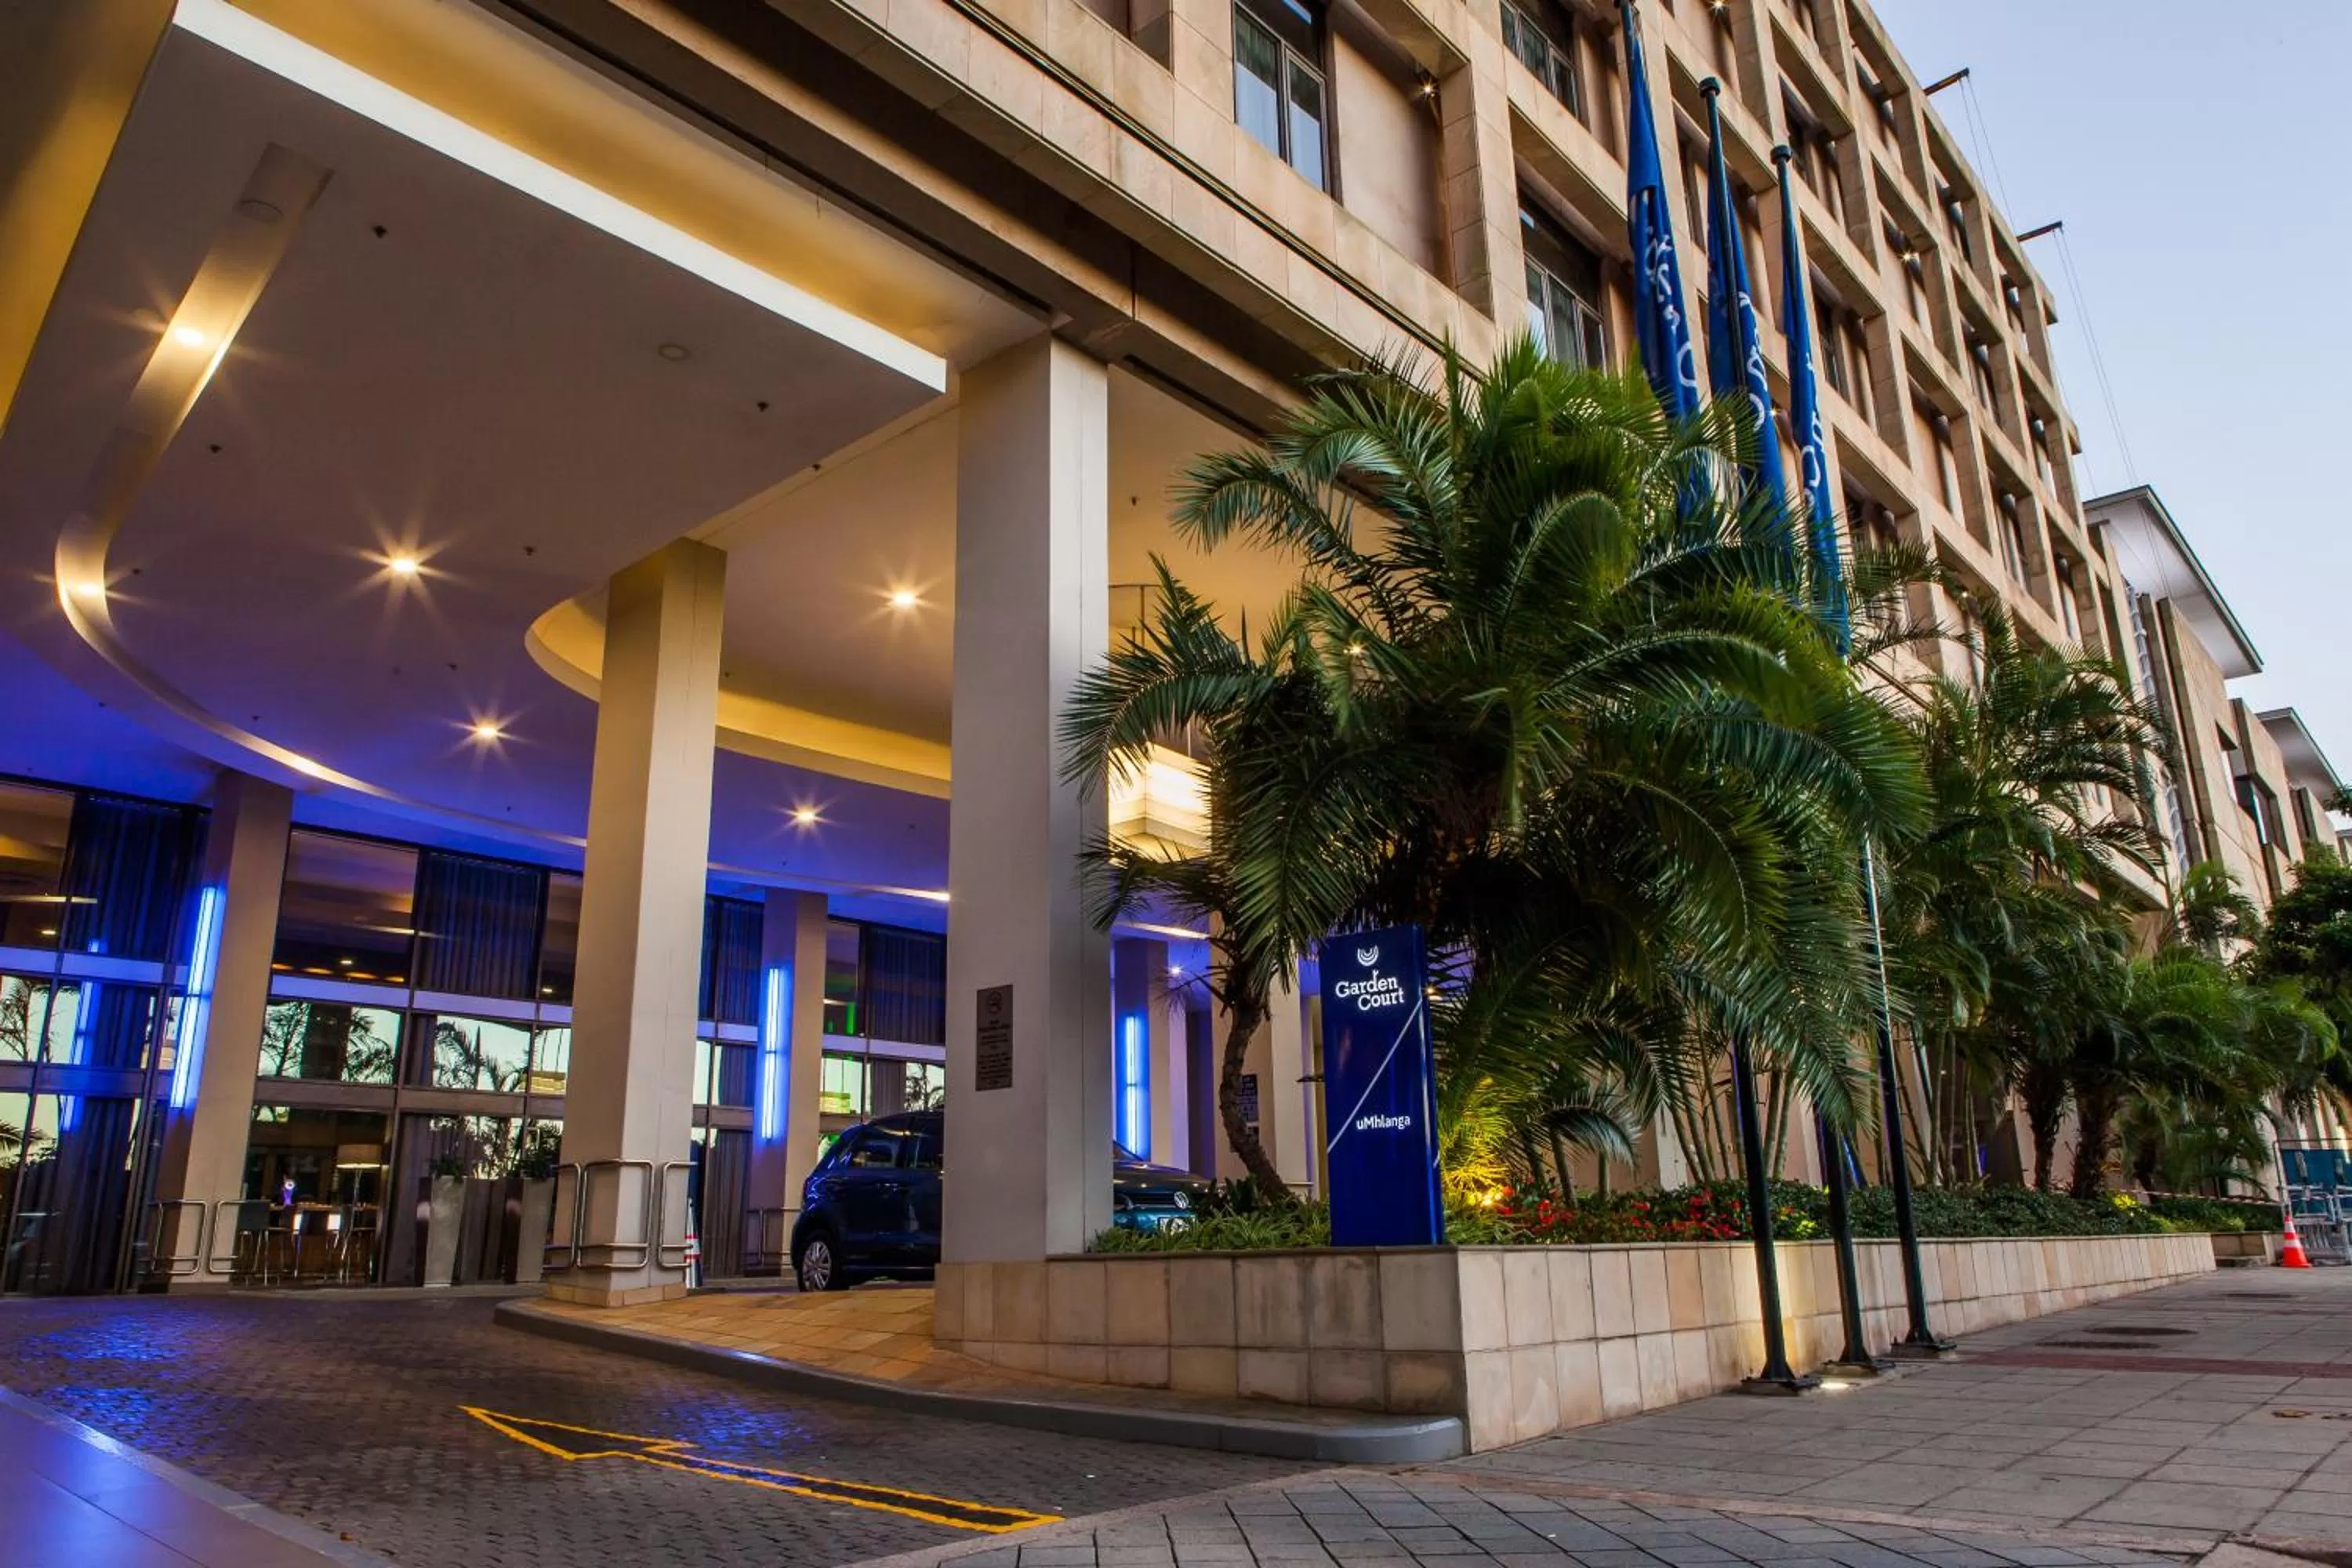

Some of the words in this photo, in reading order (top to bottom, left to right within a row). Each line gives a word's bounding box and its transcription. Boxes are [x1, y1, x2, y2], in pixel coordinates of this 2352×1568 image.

[1335, 969, 1399, 998] Garden
[1358, 987, 1405, 1011] Court
[1356, 1114, 1411, 1130] uMhlanga
